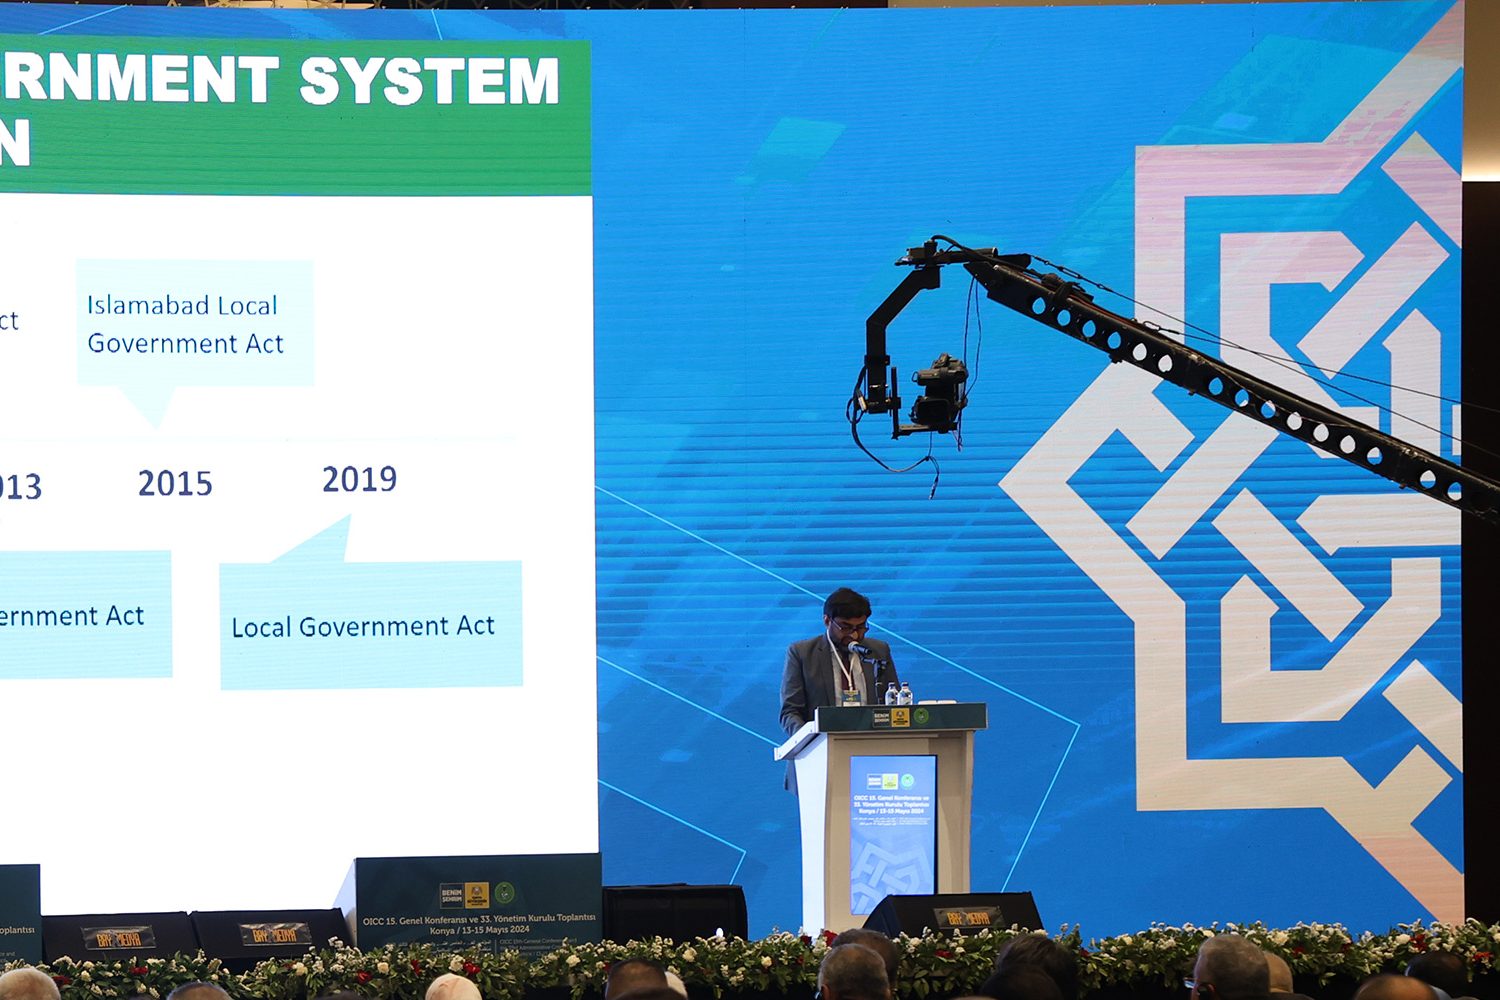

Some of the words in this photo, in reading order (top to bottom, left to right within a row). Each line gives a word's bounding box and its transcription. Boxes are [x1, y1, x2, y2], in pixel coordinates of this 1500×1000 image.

[299, 56, 558, 106] SYSTEM
[89, 294, 209, 316] Islamabad
[219, 295, 277, 316] Local
[89, 333, 237, 354] Government
[246, 333, 284, 354] Act
[139, 469, 212, 497] 2015
[324, 465, 396, 493] 2019
[105, 604, 145, 626] Act
[233, 615, 292, 638] Local
[300, 615, 449, 638] Government
[456, 614, 496, 637] Act
[363, 918, 385, 926] OICC
[386, 917, 397, 925] 15.
[399, 917, 423, 925] Genel
[425, 916, 468, 925] Konferansı
[493, 914, 527, 923] Yönetim
[528, 914, 556, 922] Kurulu
[557, 913, 597, 923] Toplantısı
[96, 933, 113, 947] BAY
[430, 927, 455, 937] Konya
[462, 927, 484, 935] 13-15
[486, 926, 509, 936] Mayıs
[510, 925, 530, 933] 2024
